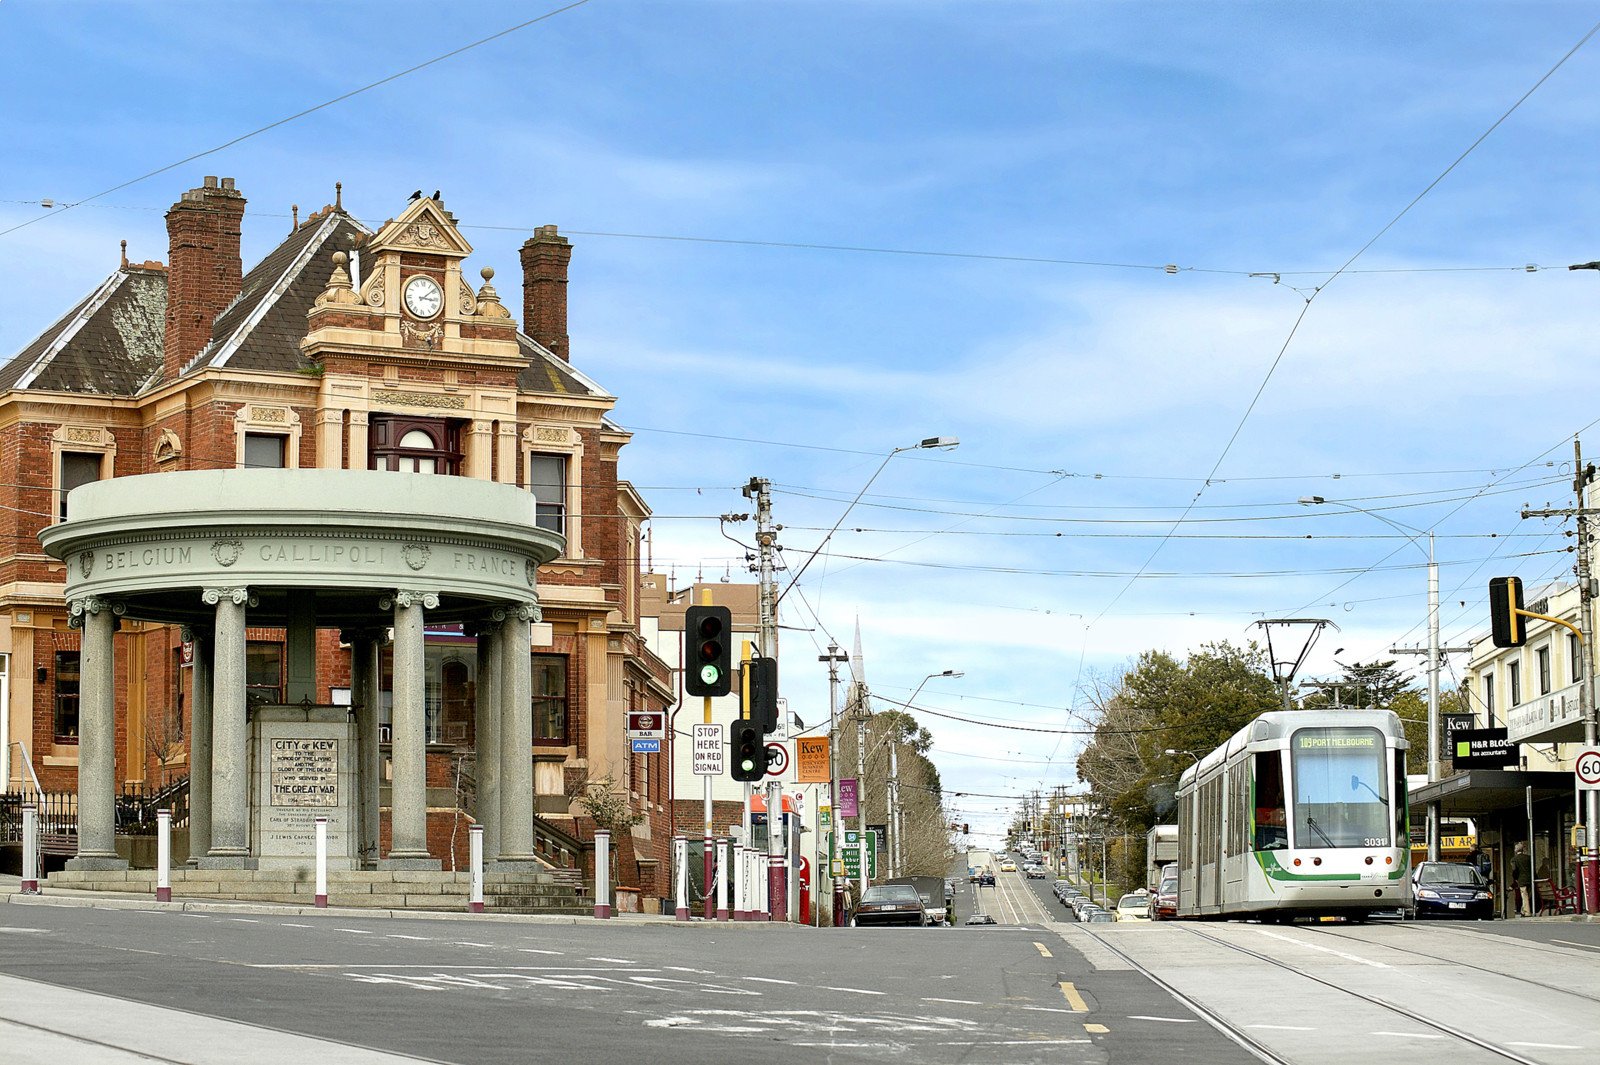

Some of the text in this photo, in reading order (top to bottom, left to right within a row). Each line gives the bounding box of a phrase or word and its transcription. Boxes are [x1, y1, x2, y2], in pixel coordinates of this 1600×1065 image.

[105, 546, 192, 571] BELGIUM
[259, 544, 385, 565] GALLIPOLI
[453, 552, 517, 576] FRANCE
[1447, 717, 1471, 730] Kew
[697, 728, 719, 737] STOP
[275, 740, 300, 750] CITY
[312, 741, 334, 750] KEW
[697, 740, 720, 750] HERE
[1300, 737, 1374, 748] 109 PORT MELBOURNE
[1471, 740, 1488, 749] H&R
[801, 742, 824, 754] Kew
[695, 752, 721, 760] ON RED
[695, 764, 721, 772] SIGNAL
[1582, 760, 1600, 775] 60
[274, 785, 335, 794] THE GREAT WAR
[840, 785, 853, 793] ew
[1364, 838, 1386, 846] 3031
